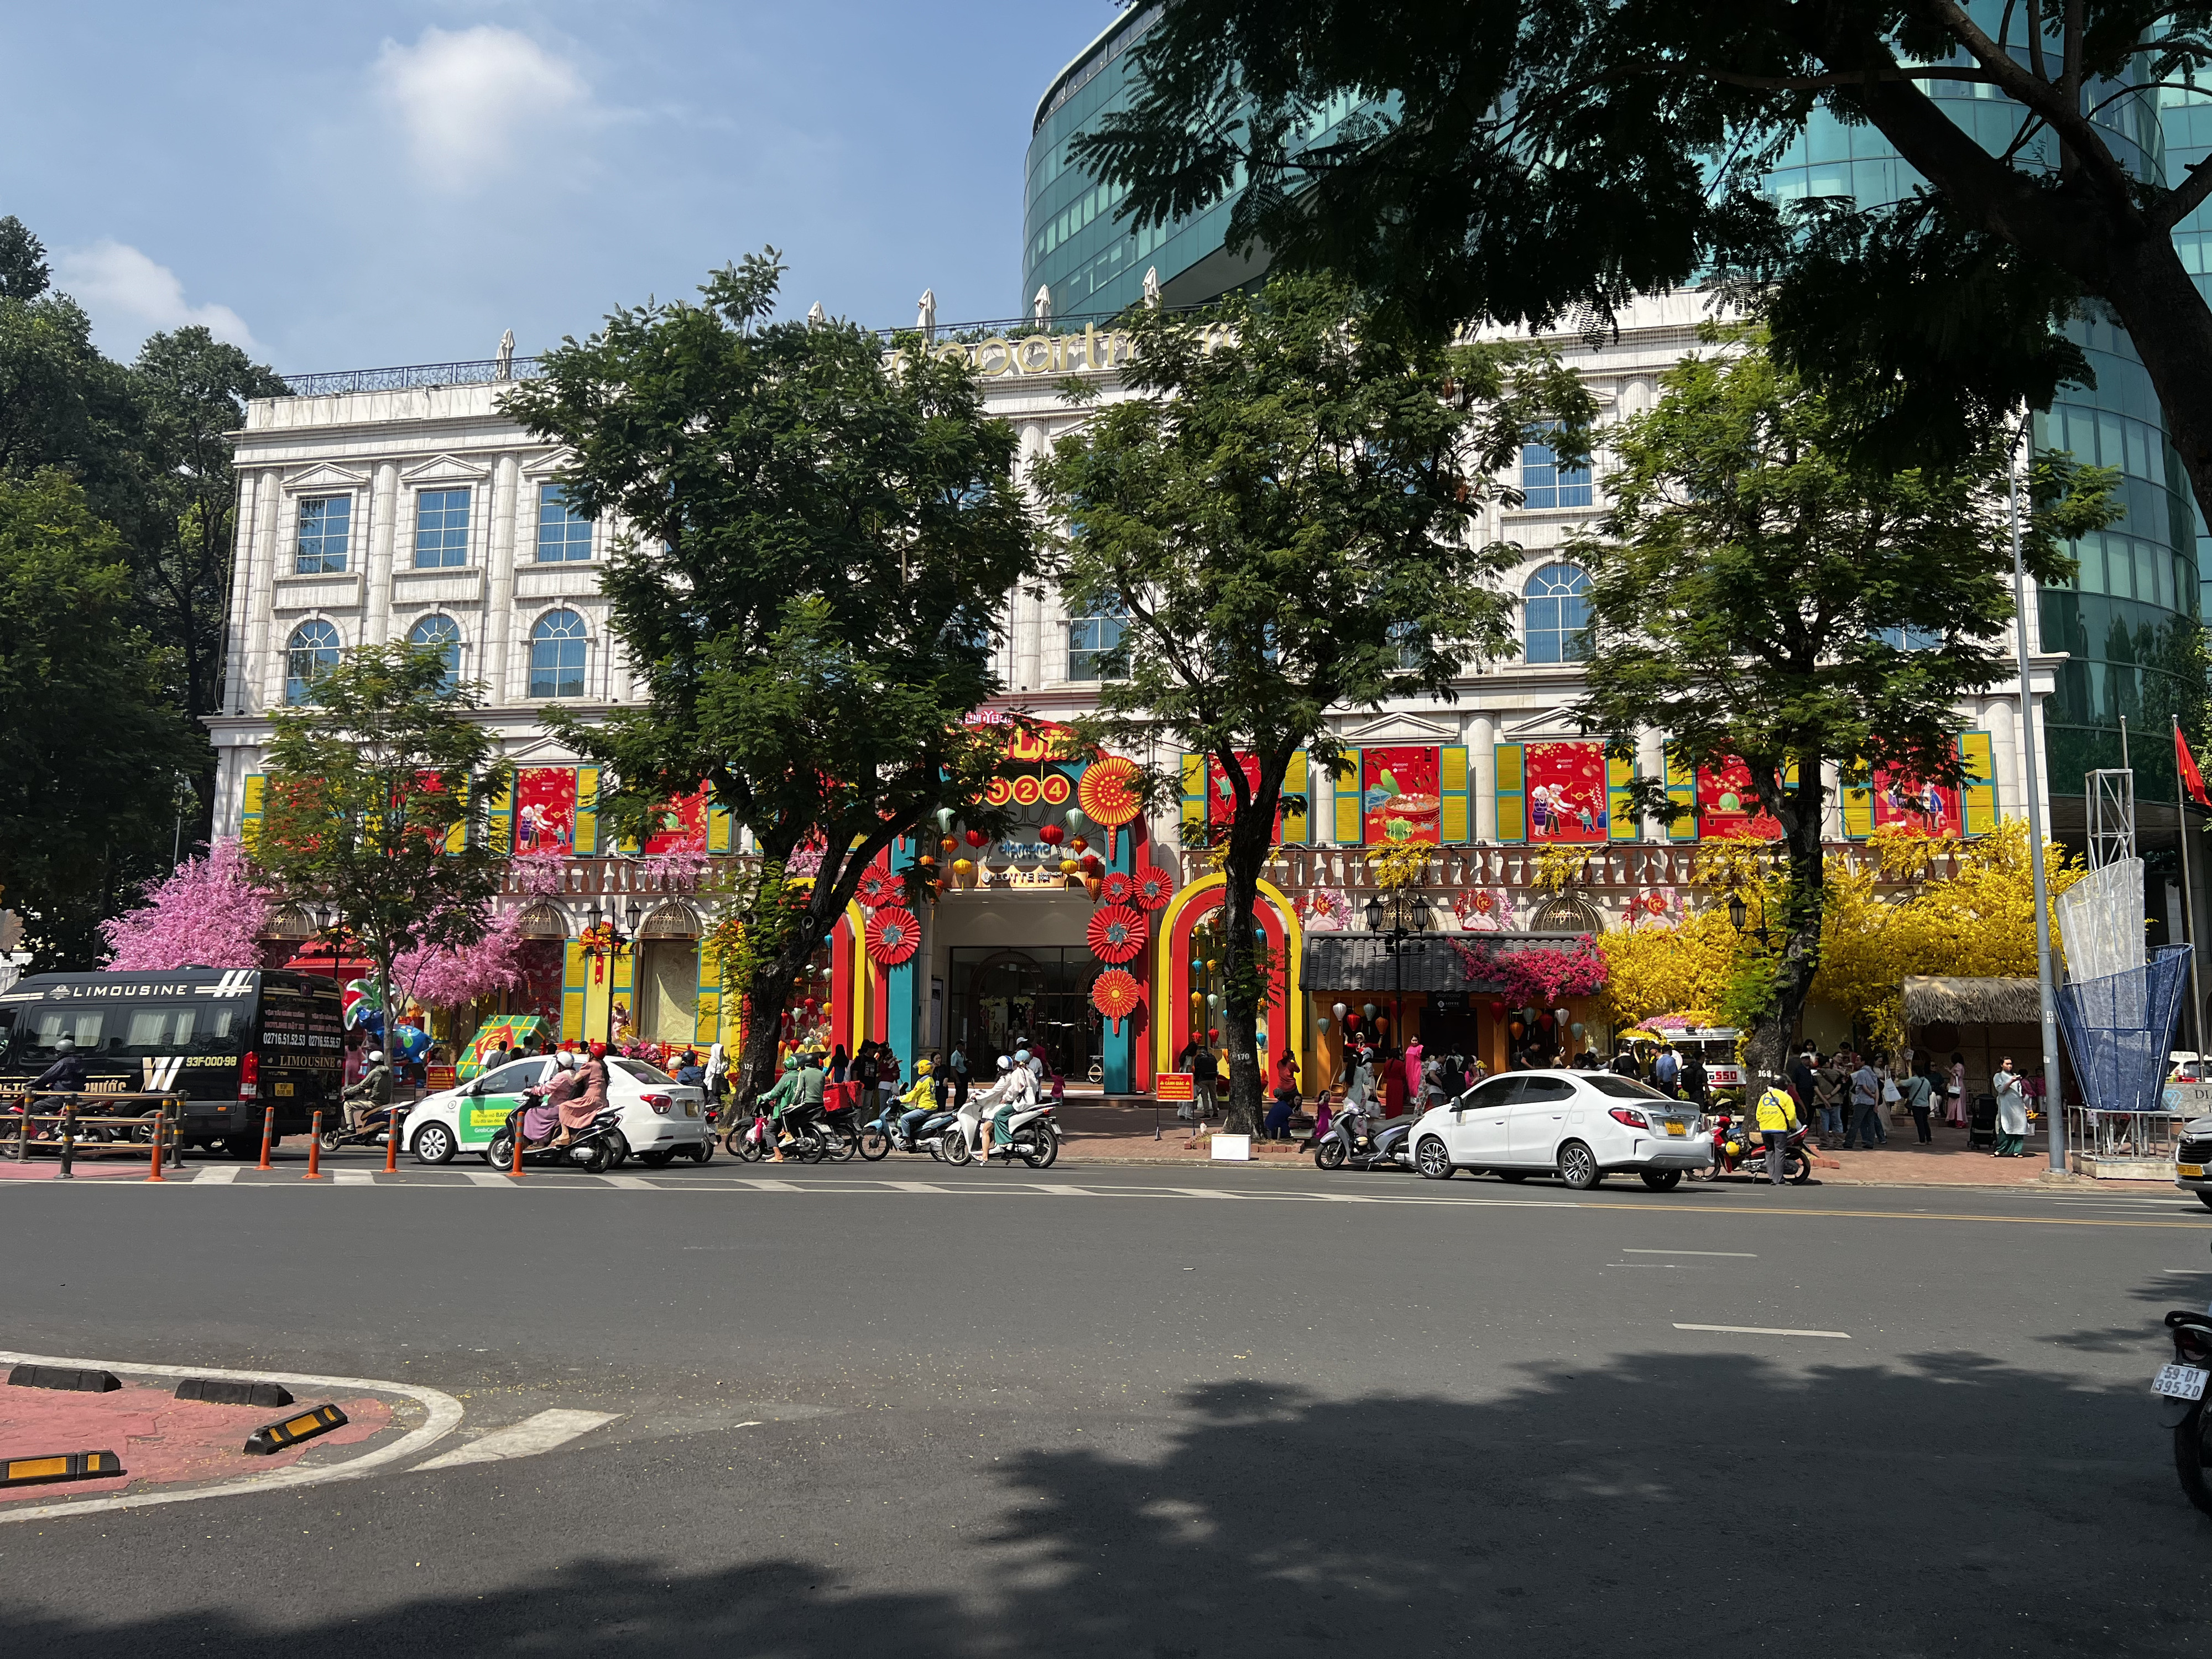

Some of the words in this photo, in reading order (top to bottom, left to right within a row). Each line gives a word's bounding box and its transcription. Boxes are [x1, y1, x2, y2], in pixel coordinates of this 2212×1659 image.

[994, 872, 1034, 881] LOTTE
[73, 985, 187, 997] LIMOUSINE
[263, 1032, 305, 1046] 02716.51.52.53
[280, 1055, 336, 1068] LIMOUSINE
[1758, 1070, 1772, 1078] 168
[2195, 1089, 2212, 1099] DI
